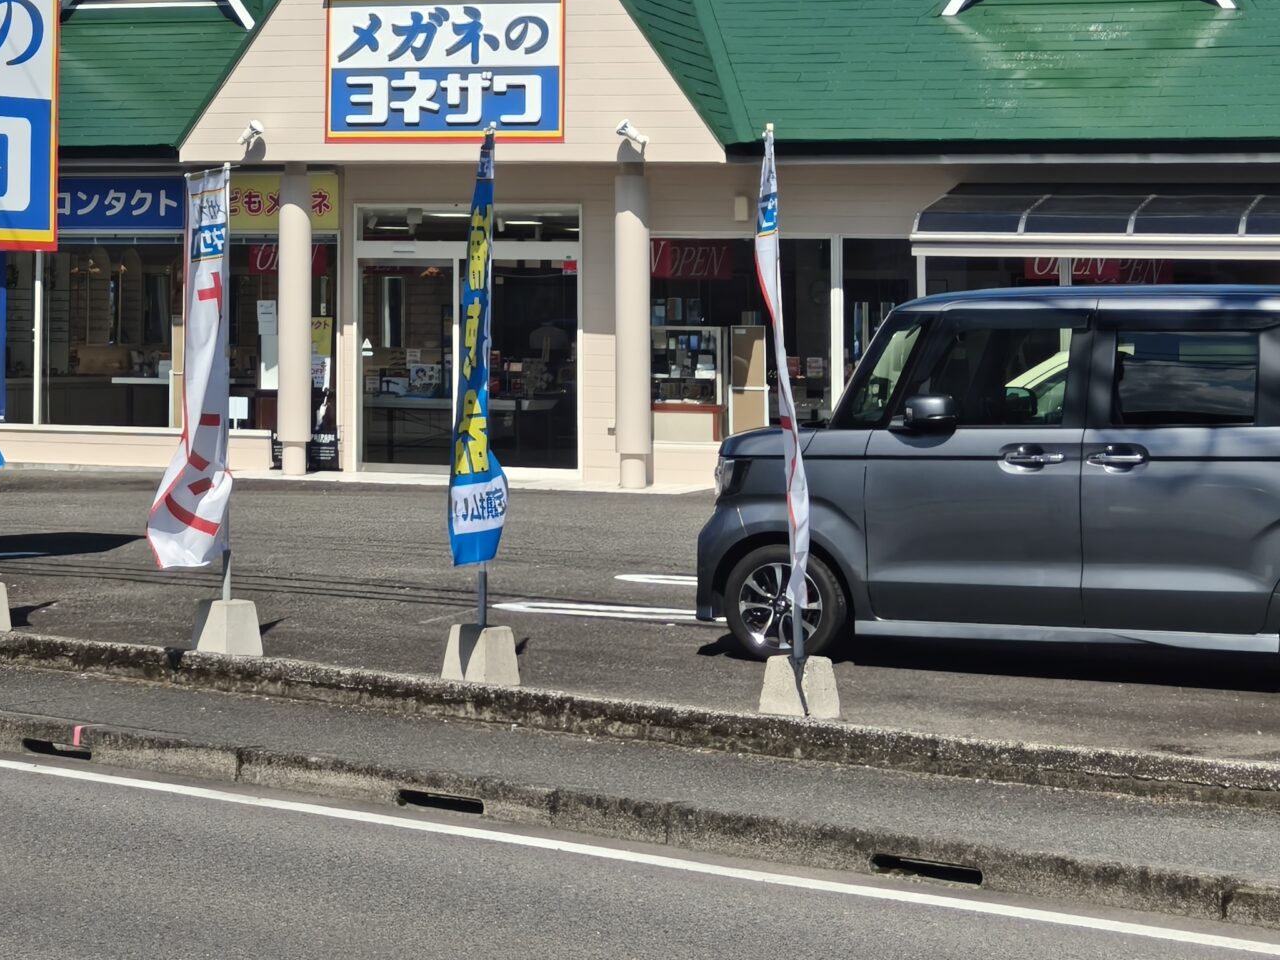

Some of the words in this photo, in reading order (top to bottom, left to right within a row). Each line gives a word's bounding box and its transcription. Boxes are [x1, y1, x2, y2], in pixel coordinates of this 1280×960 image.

[338, 6, 550, 65] メガネの
[345, 71, 543, 126] ヨネザワ
[57, 189, 178, 217] コンタクト
[230, 188, 333, 216] どもメネ
